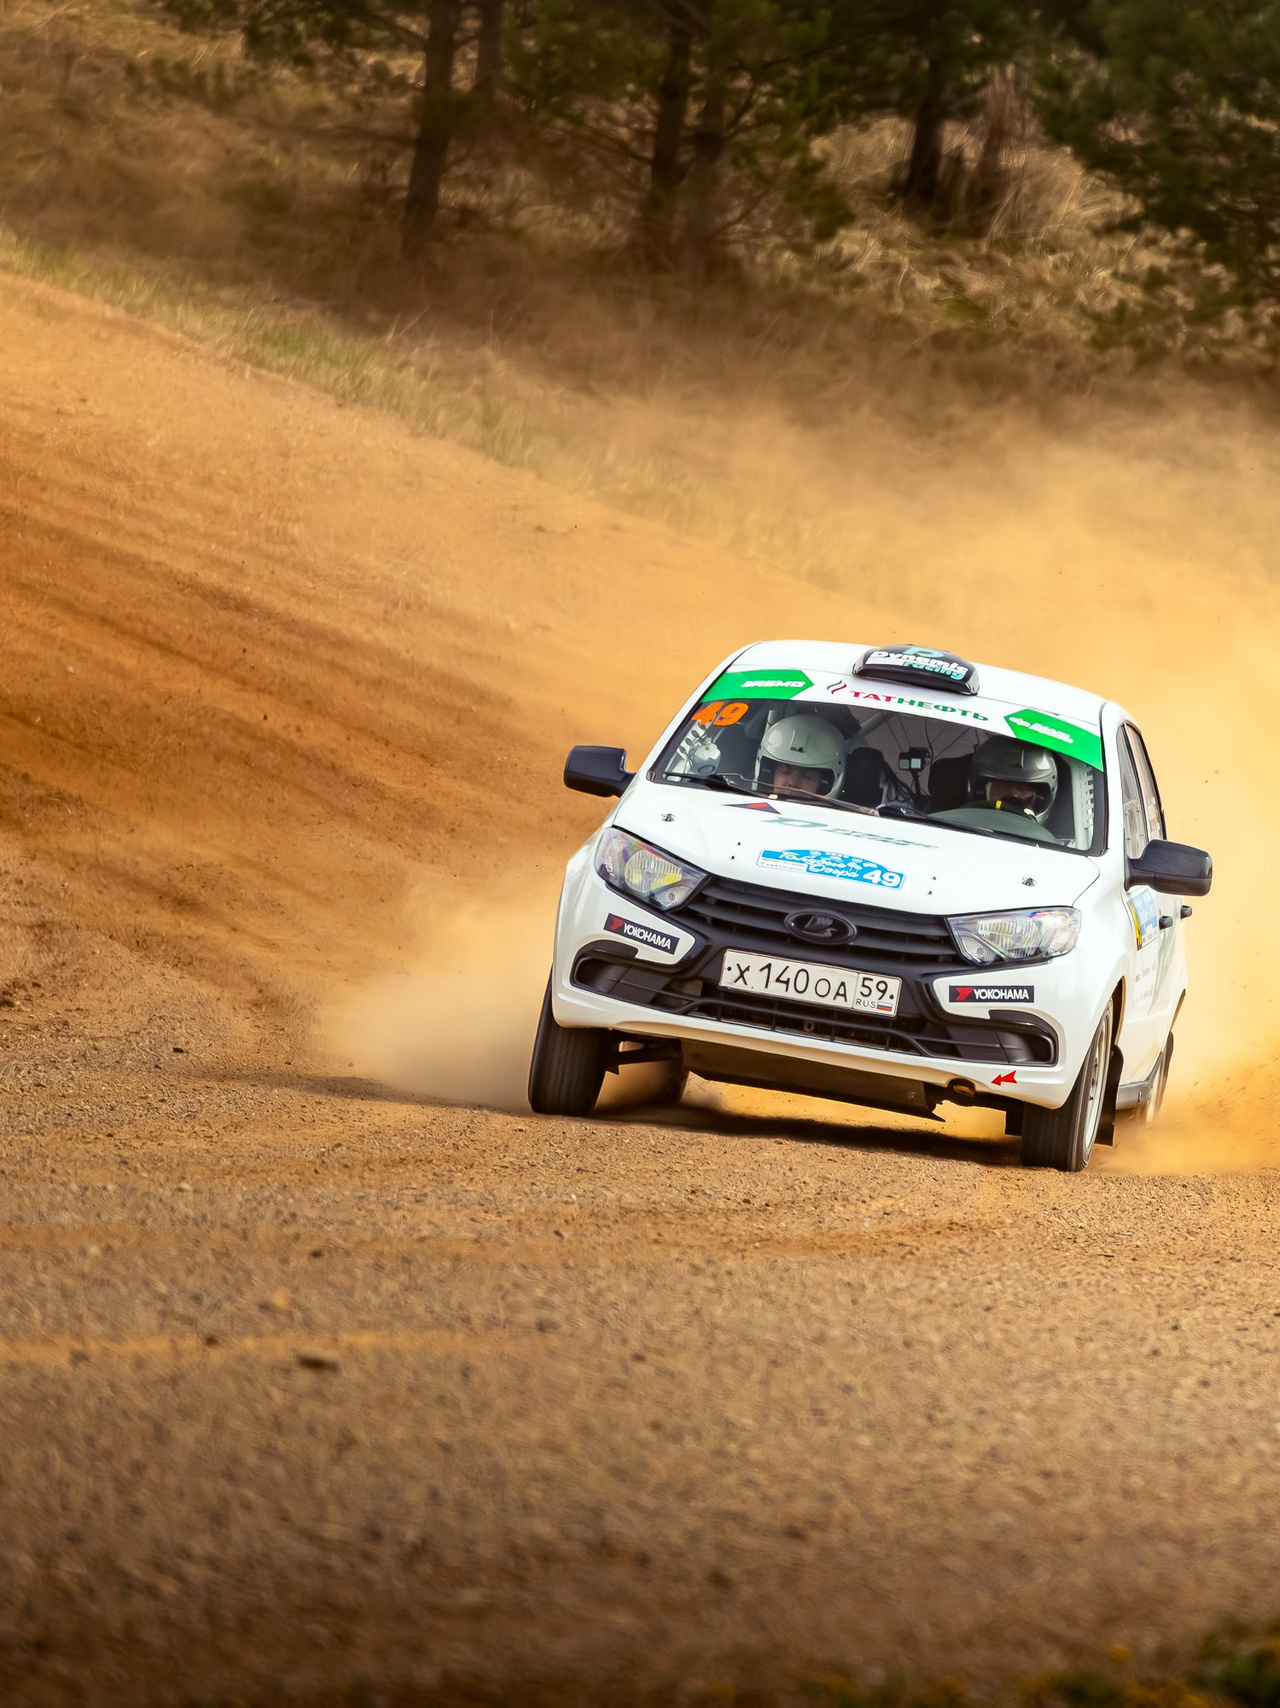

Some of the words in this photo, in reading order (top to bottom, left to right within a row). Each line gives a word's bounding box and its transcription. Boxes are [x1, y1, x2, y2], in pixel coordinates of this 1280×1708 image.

[691, 701, 750, 726] 49
[850, 690, 989, 721] ТАТНЕФТЬ
[863, 869, 901, 887] 49
[623, 922, 671, 950] YOKOHAMA
[859, 977, 888, 1001] 59
[973, 988, 1030, 1000] YOKOHAMA
[855, 998, 877, 1009] RUS
